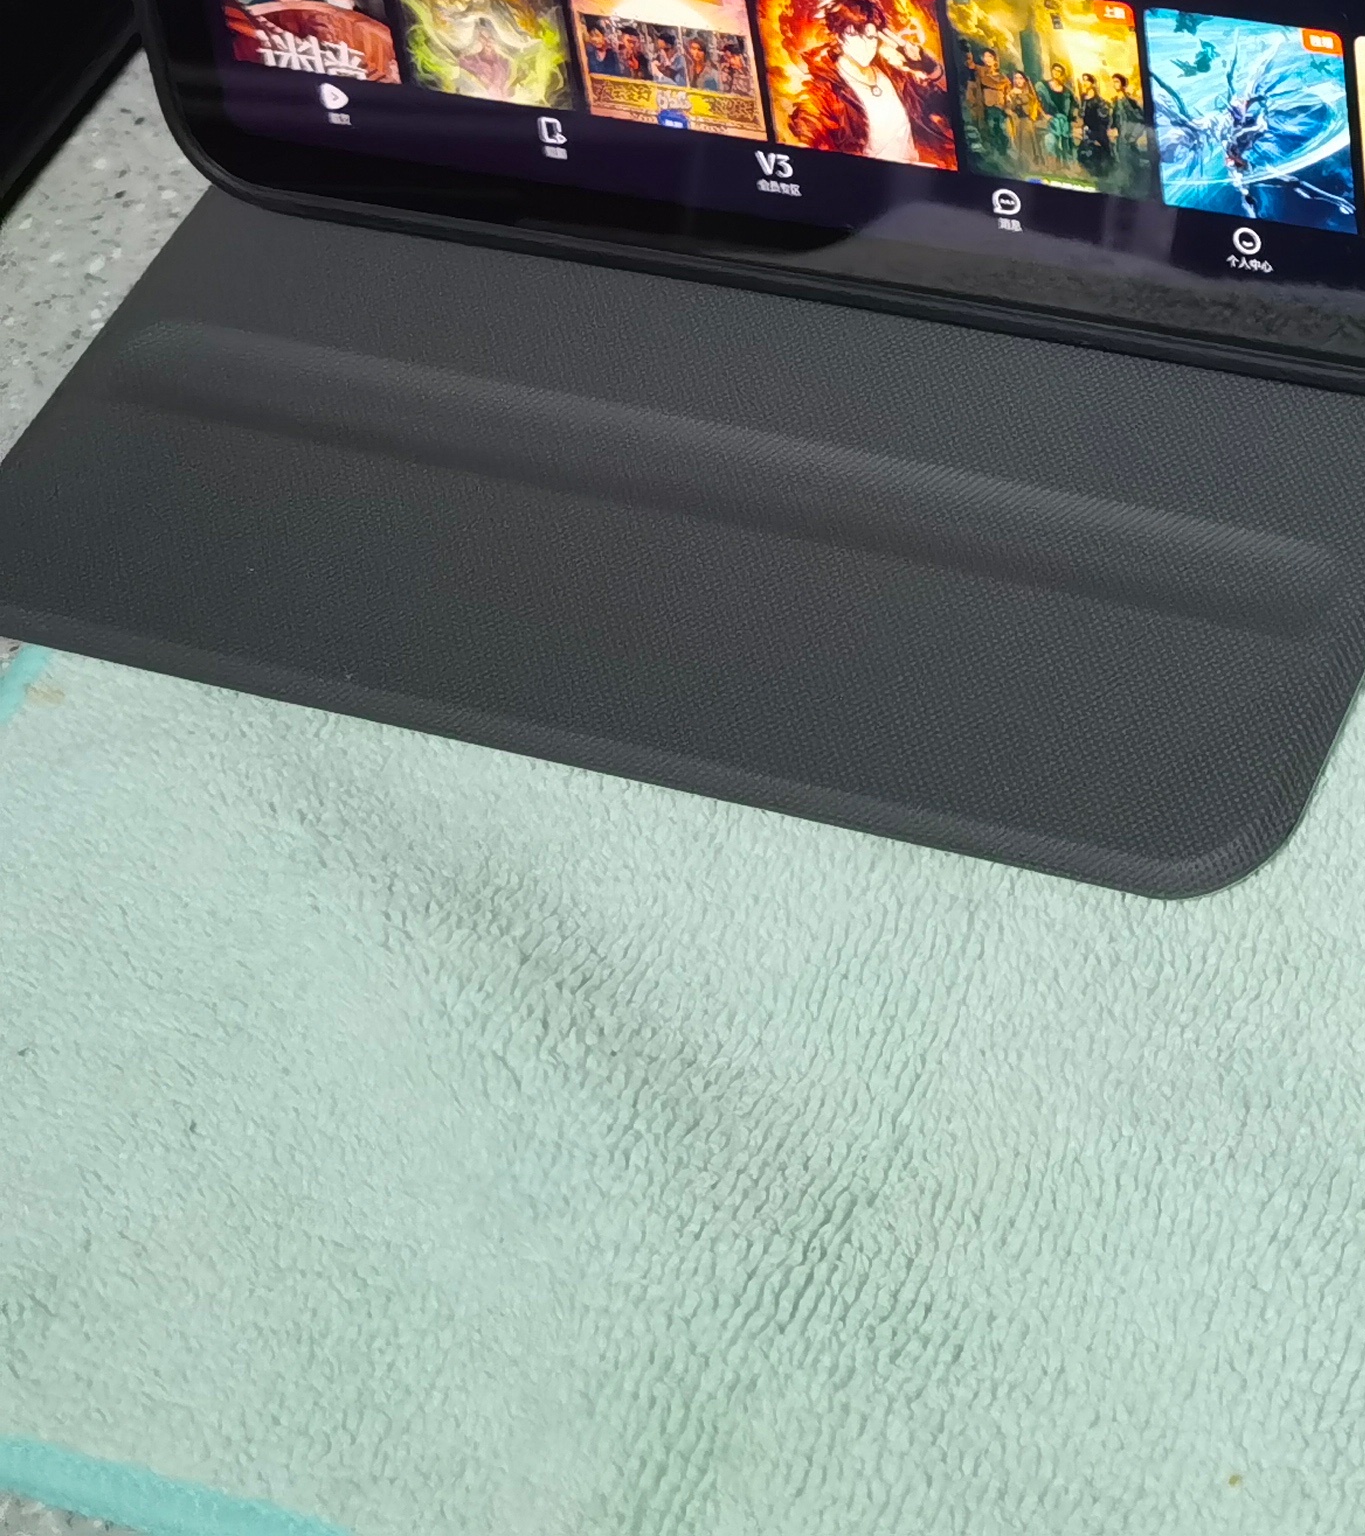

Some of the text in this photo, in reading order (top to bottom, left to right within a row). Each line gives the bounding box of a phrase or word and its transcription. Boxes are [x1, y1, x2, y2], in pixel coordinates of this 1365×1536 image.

[755, 149, 795, 179] V3
[1226, 254, 1274, 274] 个人中心
